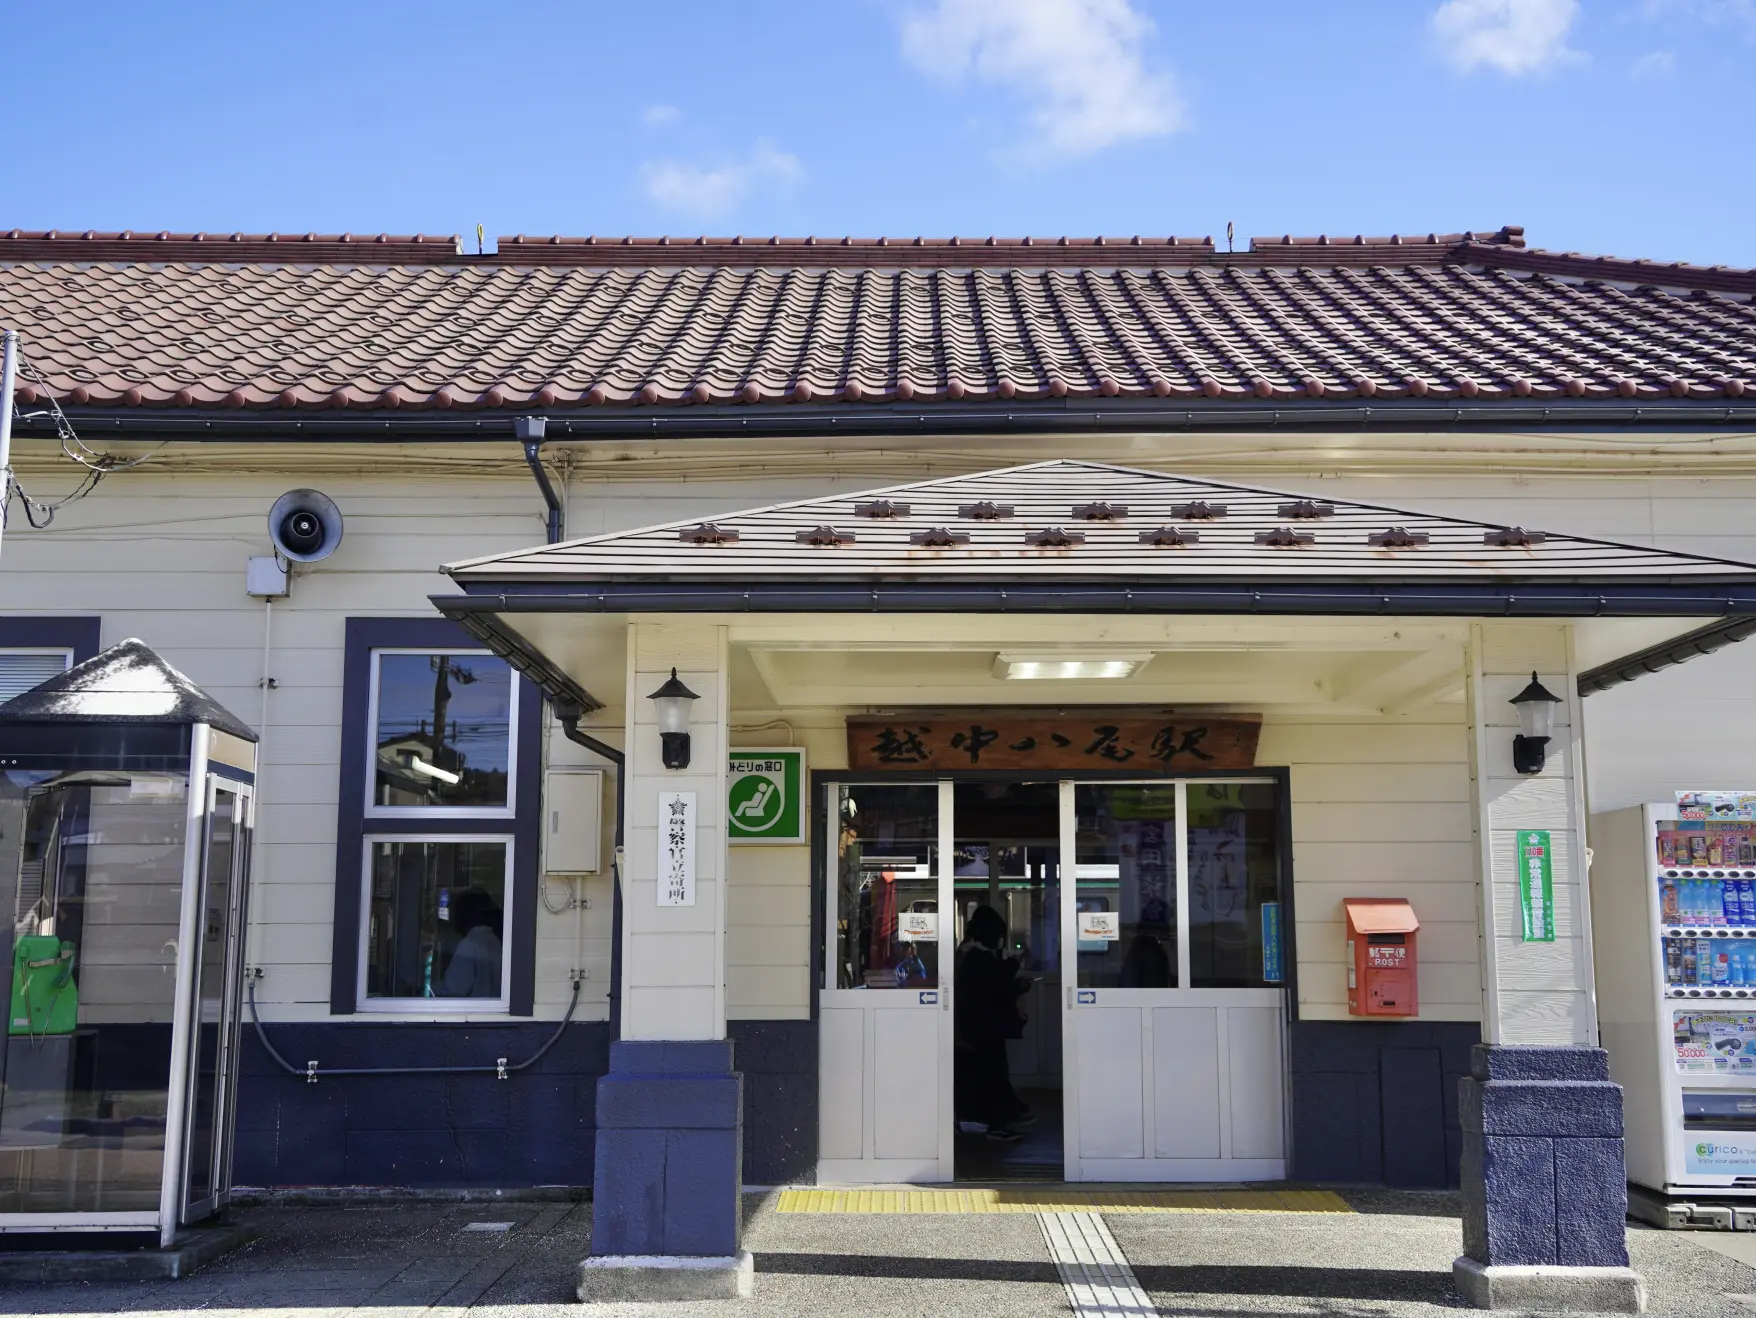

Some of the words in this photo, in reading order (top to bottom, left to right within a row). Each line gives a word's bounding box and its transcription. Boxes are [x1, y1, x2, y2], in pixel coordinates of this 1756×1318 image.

[872, 724, 1214, 763] 越中八尾駅
[729, 761, 782, 772] みどりの窓口
[1375, 958, 1400, 966] POST
[1698, 1144, 1738, 1154] curico
